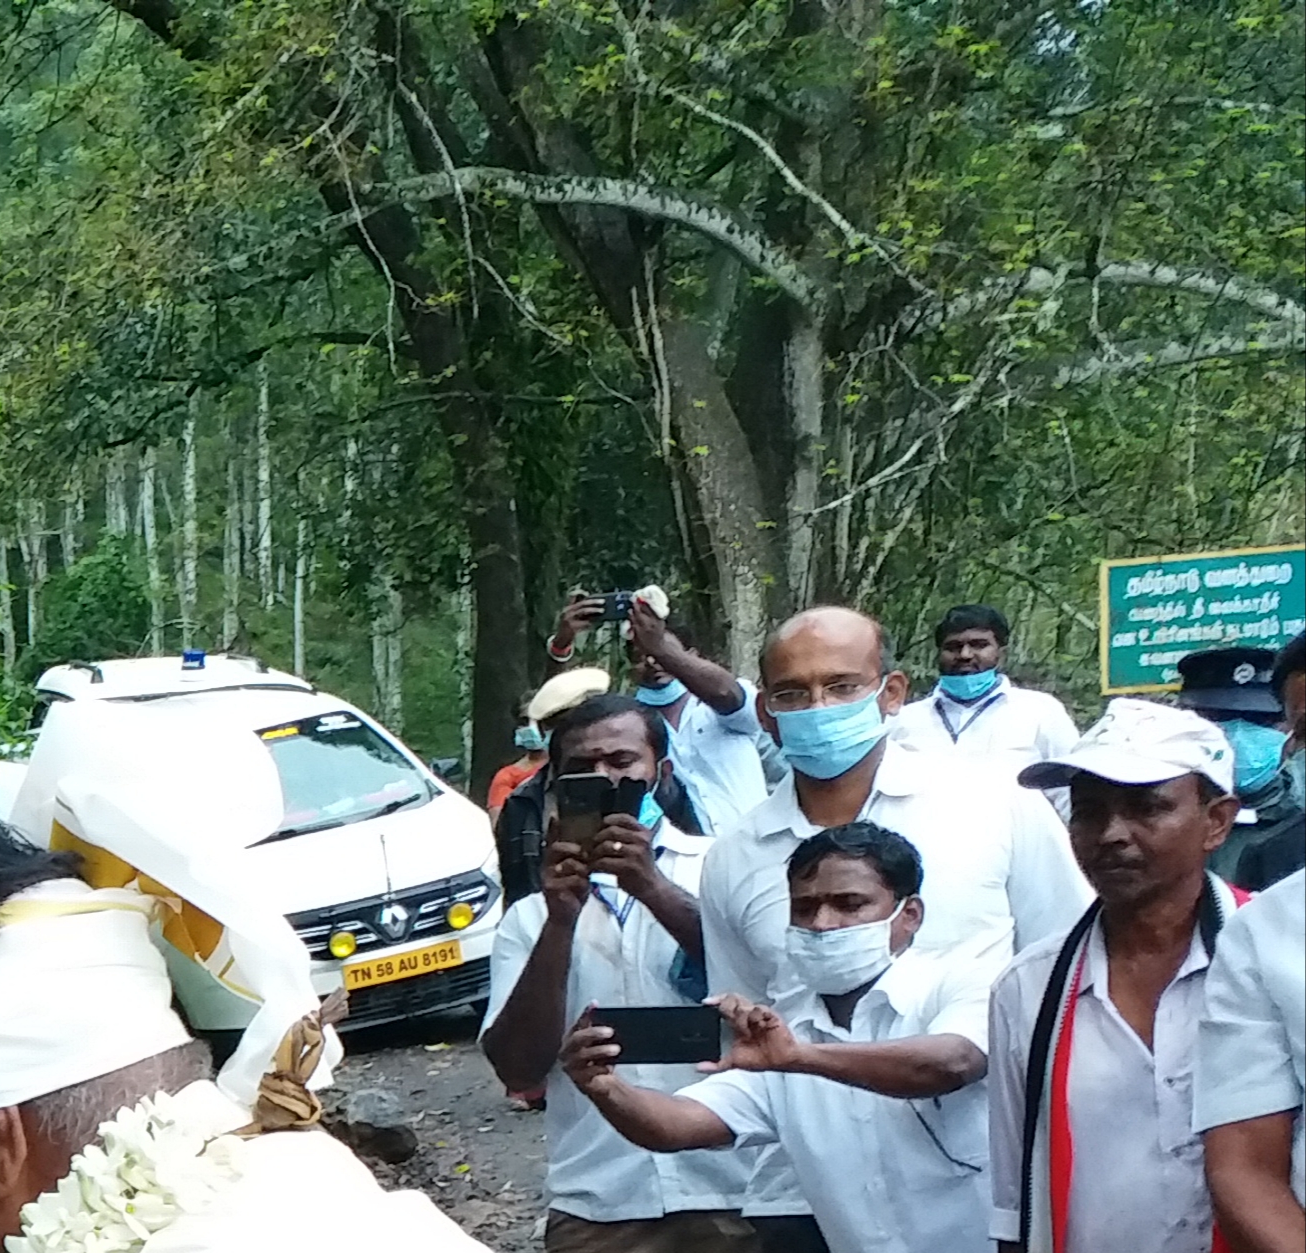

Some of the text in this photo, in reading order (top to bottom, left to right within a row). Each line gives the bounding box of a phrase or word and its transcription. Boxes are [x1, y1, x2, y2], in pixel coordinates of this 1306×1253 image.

[1123, 562, 1292, 599] தமிழ்நாடு வனத்துறை
[349, 946, 456, 983] TN 58 AU 8191
